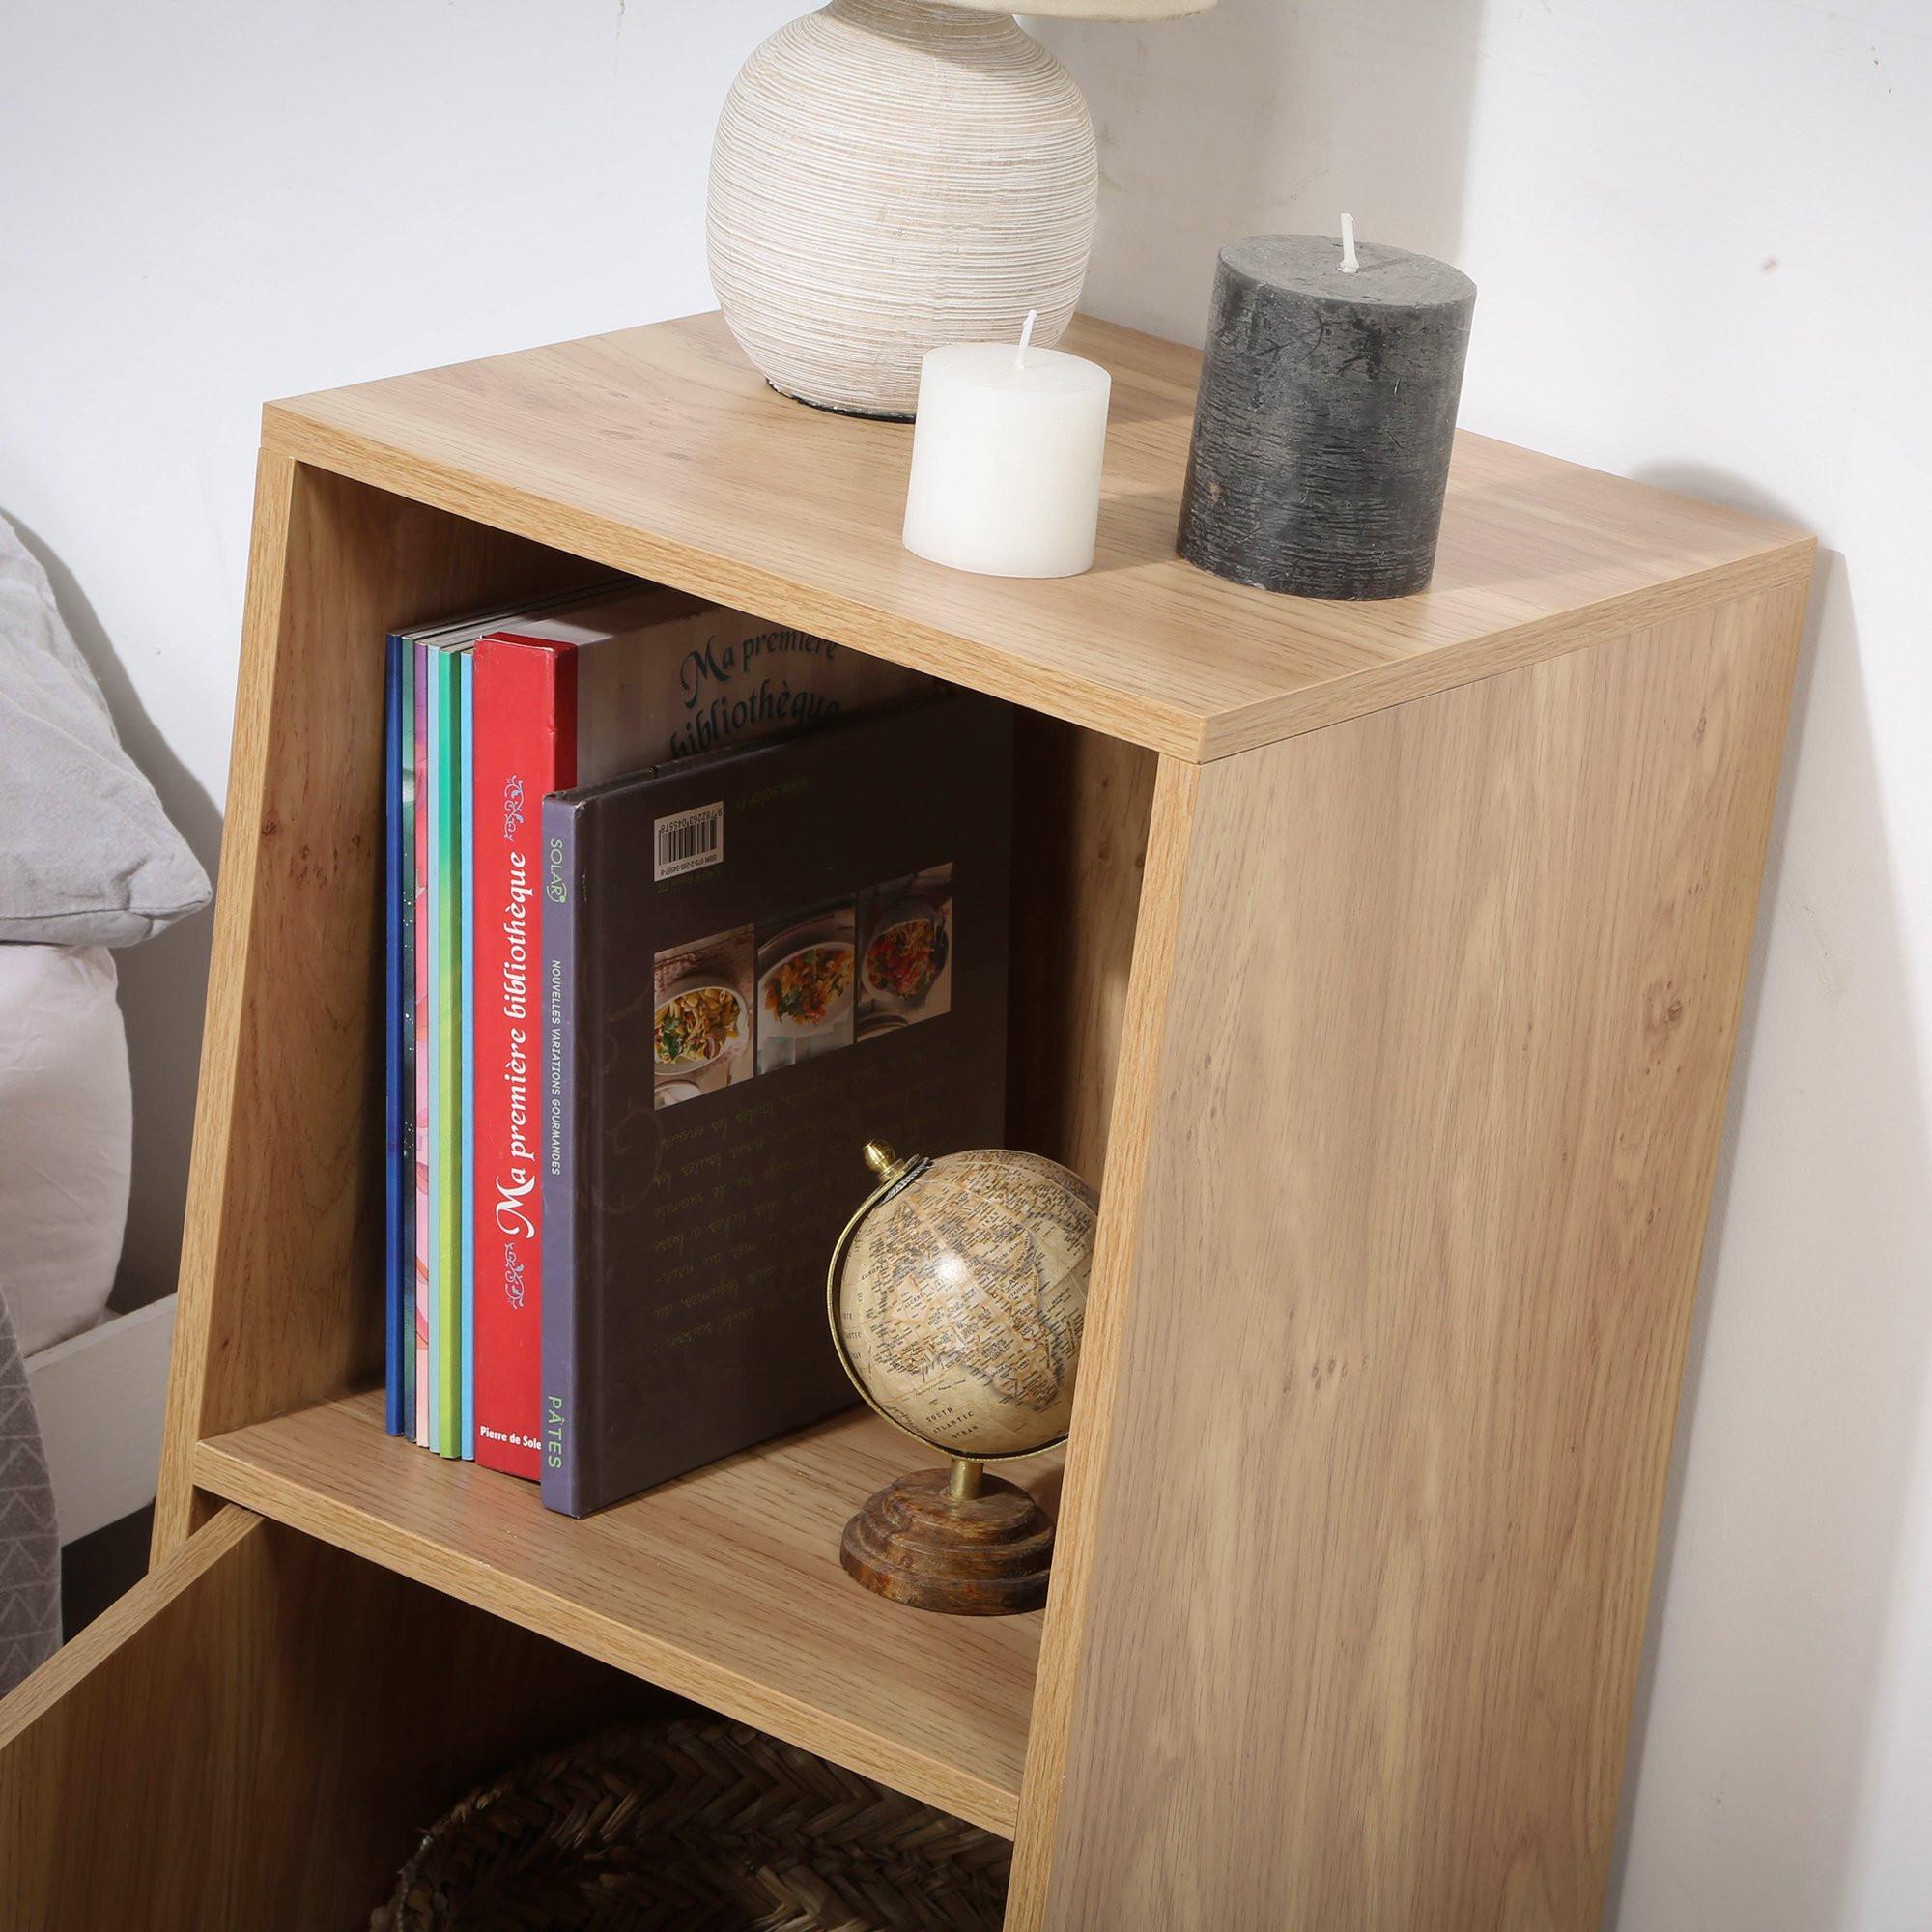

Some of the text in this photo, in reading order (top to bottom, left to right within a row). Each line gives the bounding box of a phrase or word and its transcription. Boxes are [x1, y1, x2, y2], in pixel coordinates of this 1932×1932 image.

[680, 635, 734, 708] Ma
[548, 838, 565, 901] SOLAR
[496, 851, 535, 1239] Ma première bibliothèque
[551, 959, 562, 1176] NOUVELLES VARIATIONS GOURMANDES
[479, 1425, 508, 1442] Pierre
[509, 1433, 521, 1445] de
[548, 1396, 565, 1469] PÂTES
[925, 1406, 953, 1424] SOUTH
[933, 1410, 975, 1435] ATLANTIC
[952, 1424, 979, 1439] OCEAN
